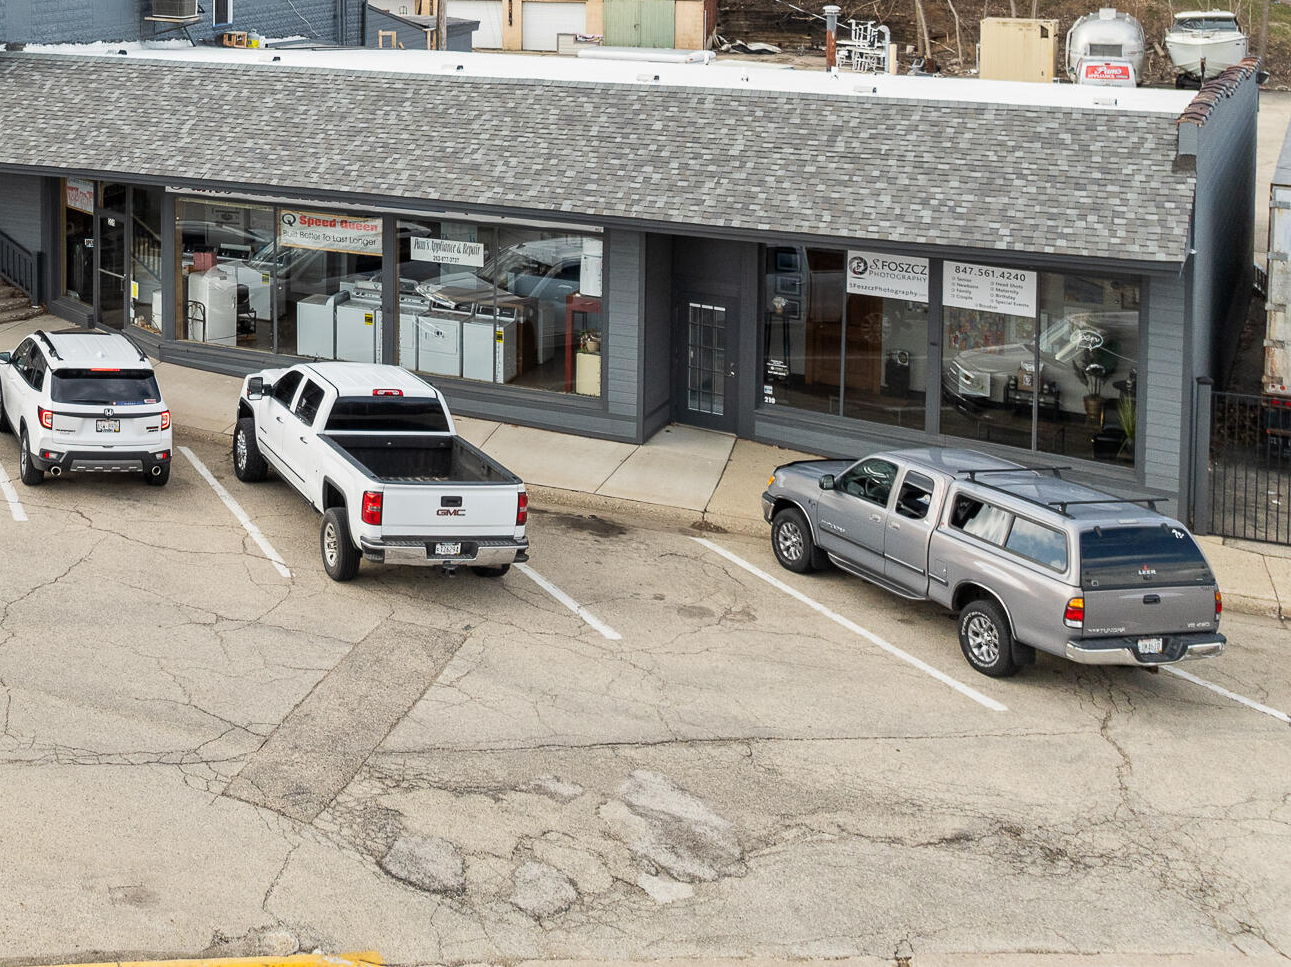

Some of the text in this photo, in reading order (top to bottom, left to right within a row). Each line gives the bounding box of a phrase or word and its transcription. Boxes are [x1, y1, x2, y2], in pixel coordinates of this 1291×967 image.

[299, 216, 336, 228] Speed
[340, 220, 379, 232] Queen
[283, 230, 377, 247] Built Better To Last Longer
[431, 240, 456, 254] Appliance
[457, 244, 462, 252] &
[463, 244, 482, 257] Repair
[868, 269, 928, 283] PHOTOGRAPHY
[954, 265, 1026, 282] 847.561.4240
[996, 287, 1019, 295] Maternity
[996, 293, 1016, 301] Birthday
[764, 396, 776, 404] 210
[436, 509, 467, 517] GMC
